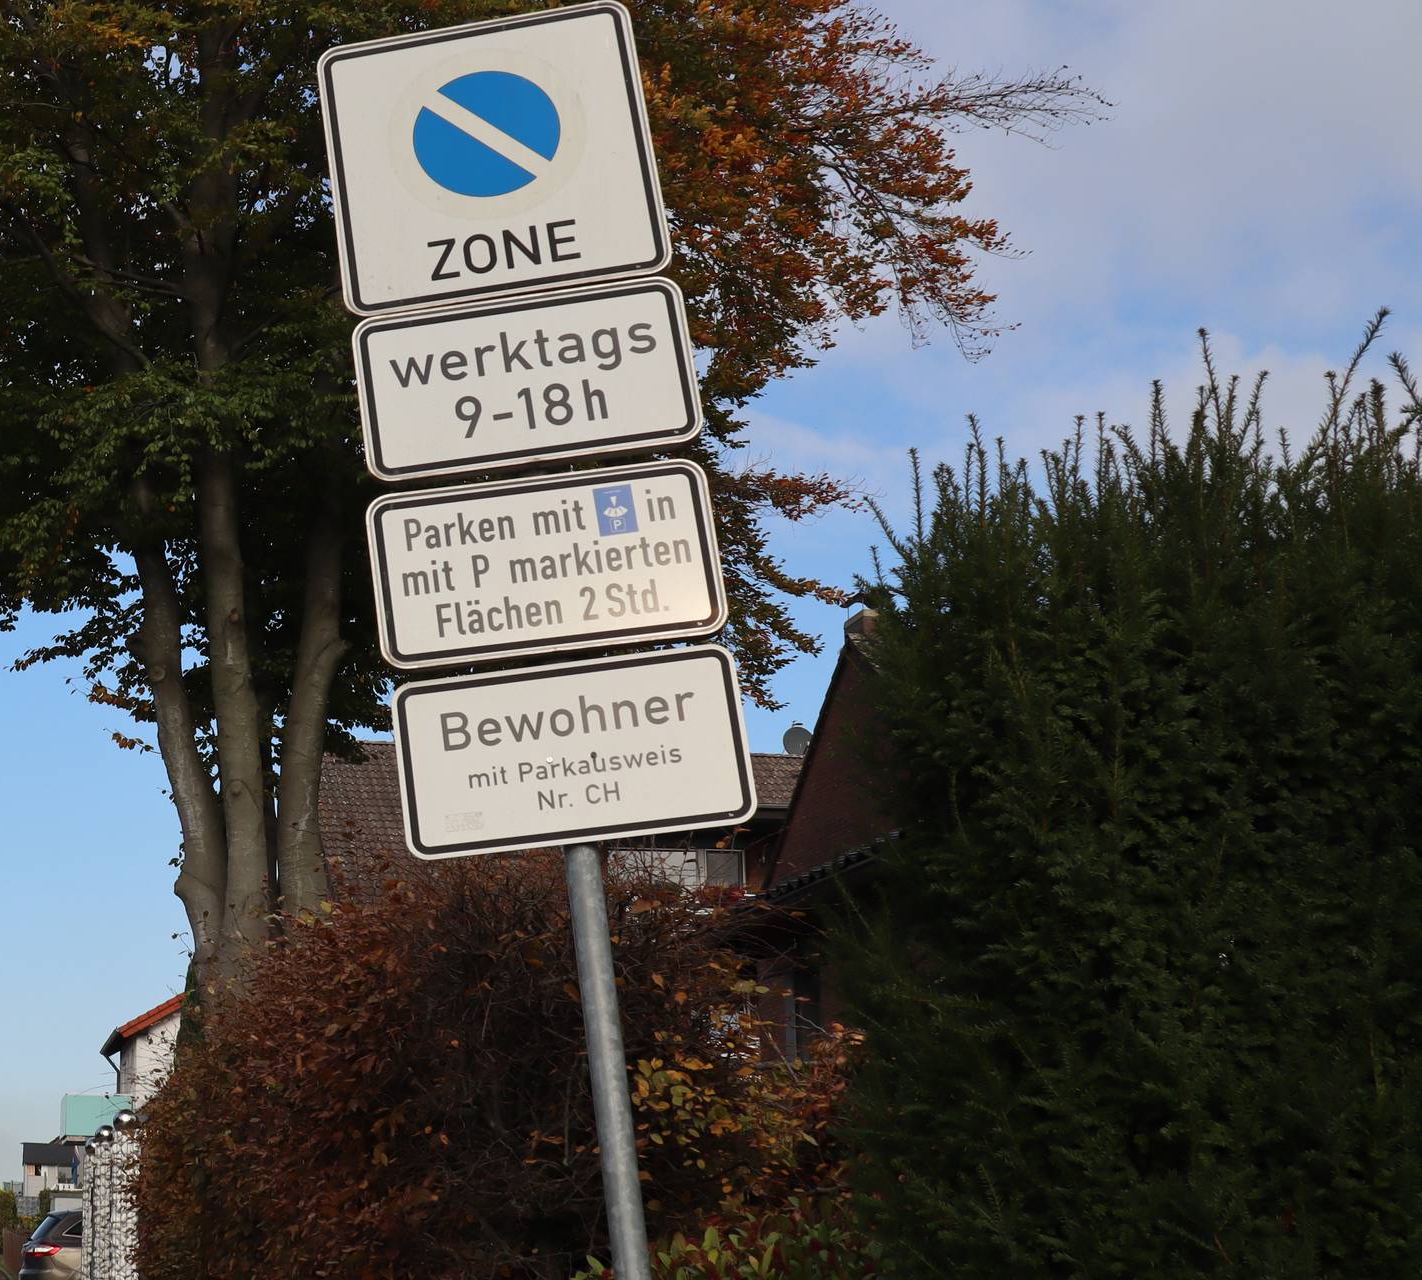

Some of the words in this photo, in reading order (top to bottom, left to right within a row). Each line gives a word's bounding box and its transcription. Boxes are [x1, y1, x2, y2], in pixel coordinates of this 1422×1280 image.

[427, 219, 581, 281] ZONE
[389, 322, 657, 389] werktags
[454, 379, 609, 439] 9-18h
[403, 511, 516, 552] Parken
[532, 500, 586, 537] mit
[645, 489, 676, 523] in
[402, 559, 455, 597] mit
[472, 554, 490, 588] P
[509, 538, 692, 584] markierten
[435, 596, 563, 638] Flächen
[579, 586, 598, 621] 2
[606, 579, 670, 617] Std.
[440, 691, 695, 752] Bewohner
[468, 766, 508, 789] mit
[518, 744, 683, 784] Parkausweis
[538, 788, 574, 811] Nr.
[585, 781, 621, 804] CH
